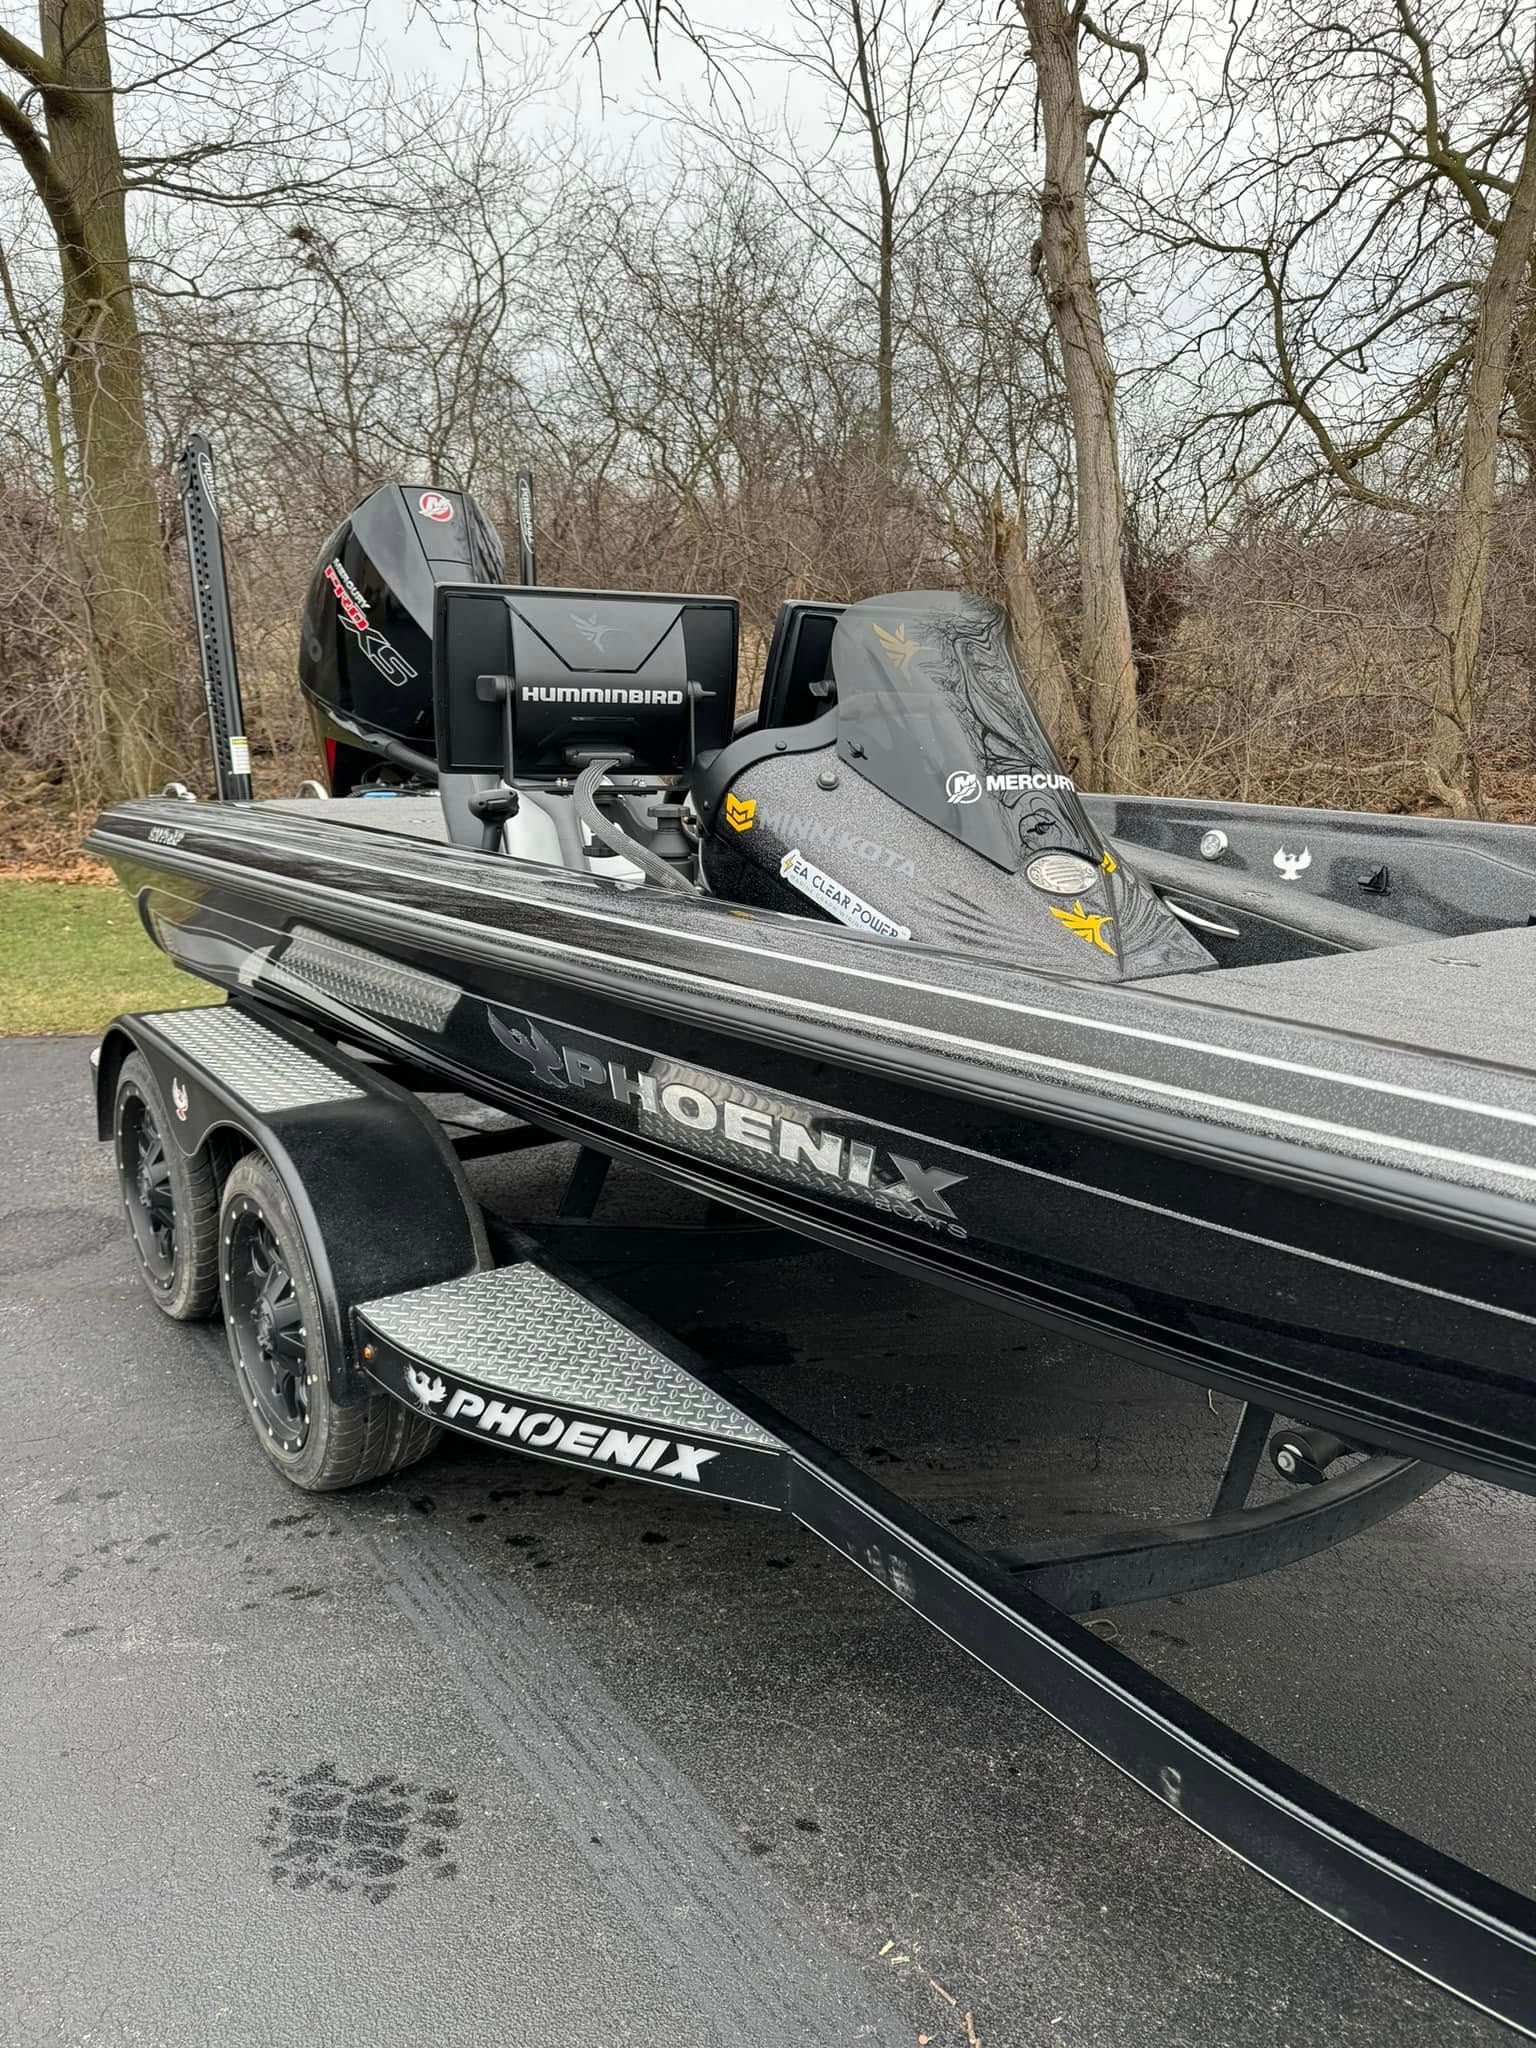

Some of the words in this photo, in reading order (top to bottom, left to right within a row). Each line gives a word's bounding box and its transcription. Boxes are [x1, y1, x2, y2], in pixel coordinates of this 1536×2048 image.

[324, 563, 369, 631] PRO
[333, 557, 371, 609] MERCURY
[337, 614, 418, 687] XS
[522, 686, 683, 705] HUMMINBIRD
[838, 831, 915, 878] KOTA
[812, 875, 851, 909] CLEAR
[851, 903, 899, 938] POWER
[562, 1046, 968, 1219] PHOENIX
[874, 1194, 967, 1239] BOATS
[444, 1389, 720, 1482] PHOENIX
